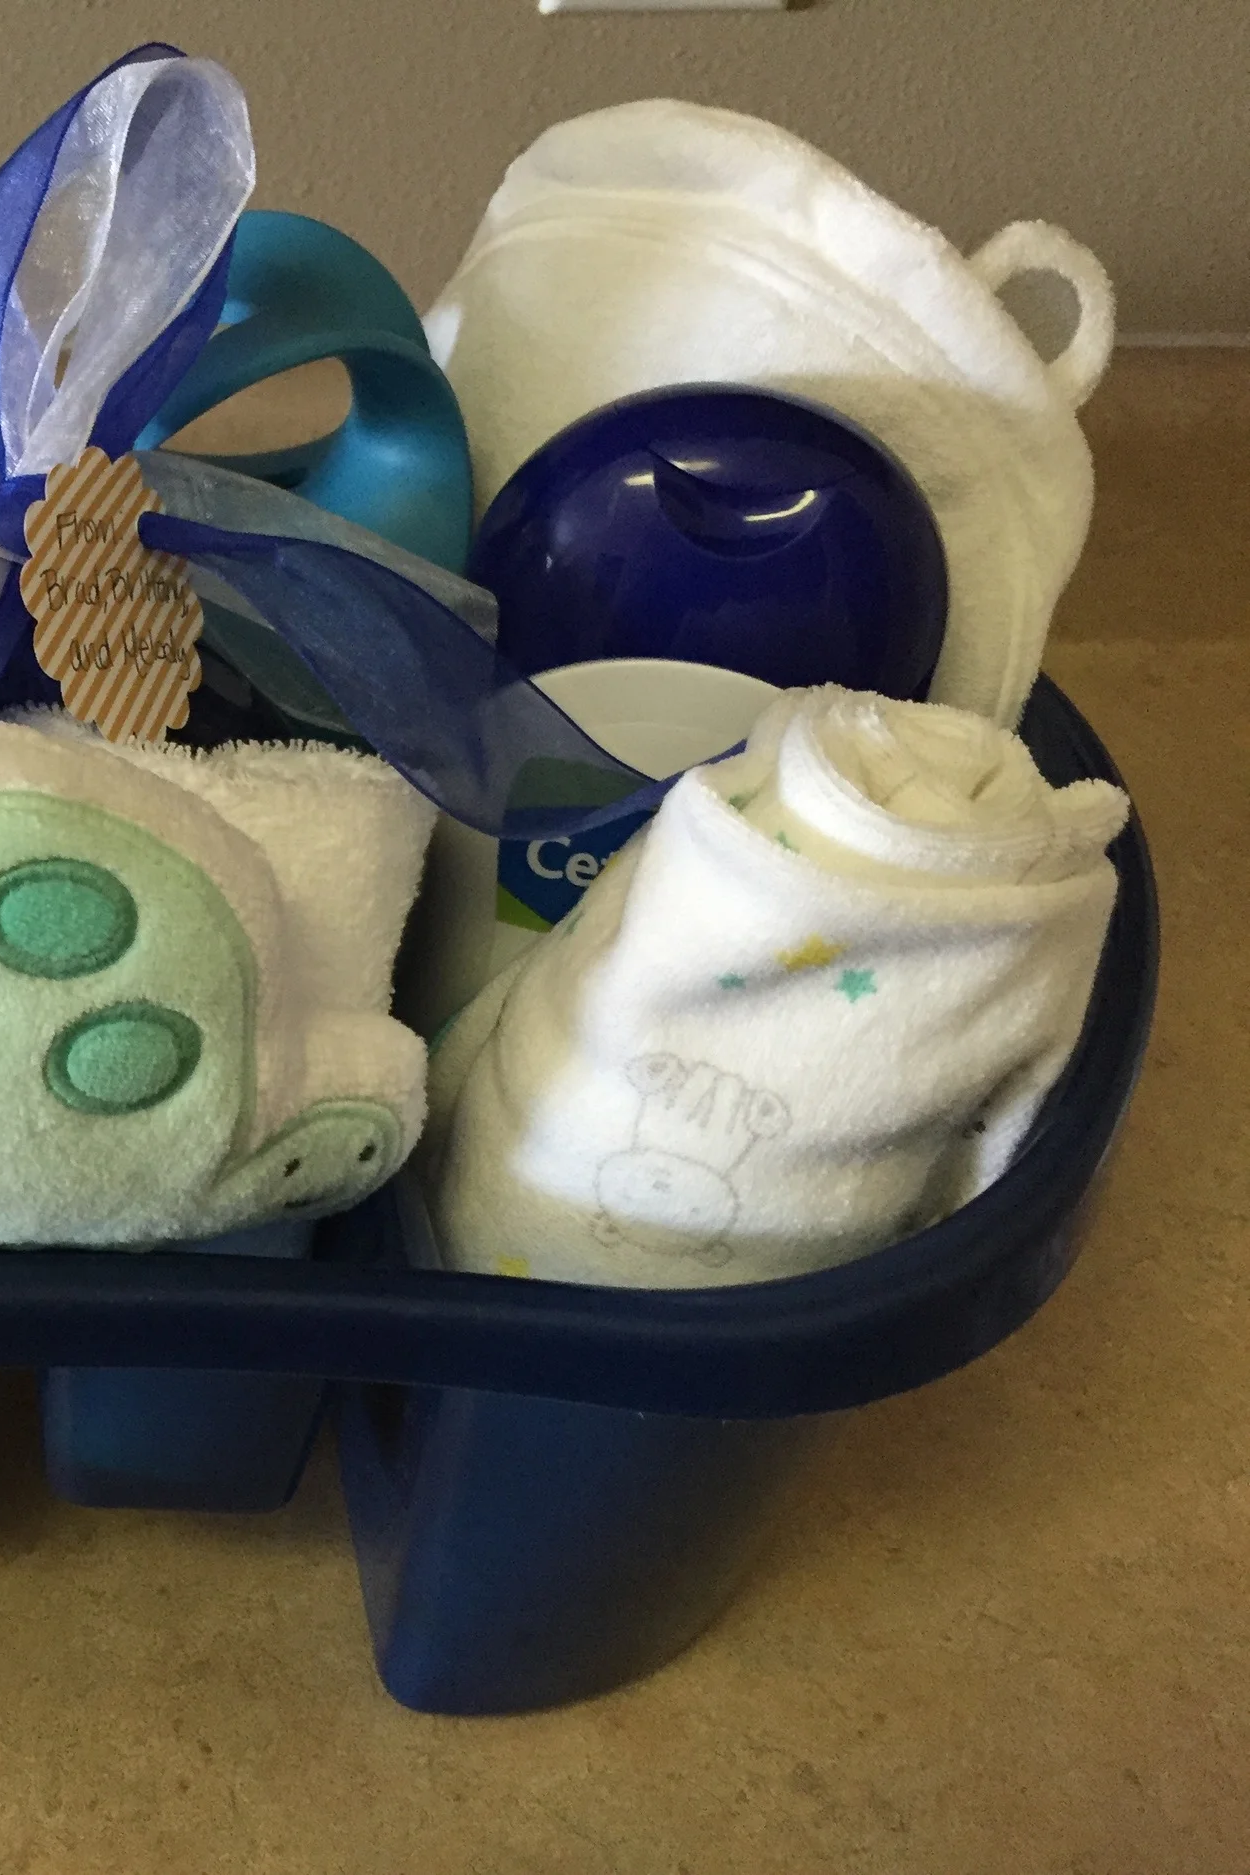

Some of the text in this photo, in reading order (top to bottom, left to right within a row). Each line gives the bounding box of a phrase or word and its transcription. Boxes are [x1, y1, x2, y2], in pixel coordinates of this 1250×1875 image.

[56, 510, 119, 549] From
[70, 618, 191, 681] and Melody
[526, 837, 616, 888] Ce
